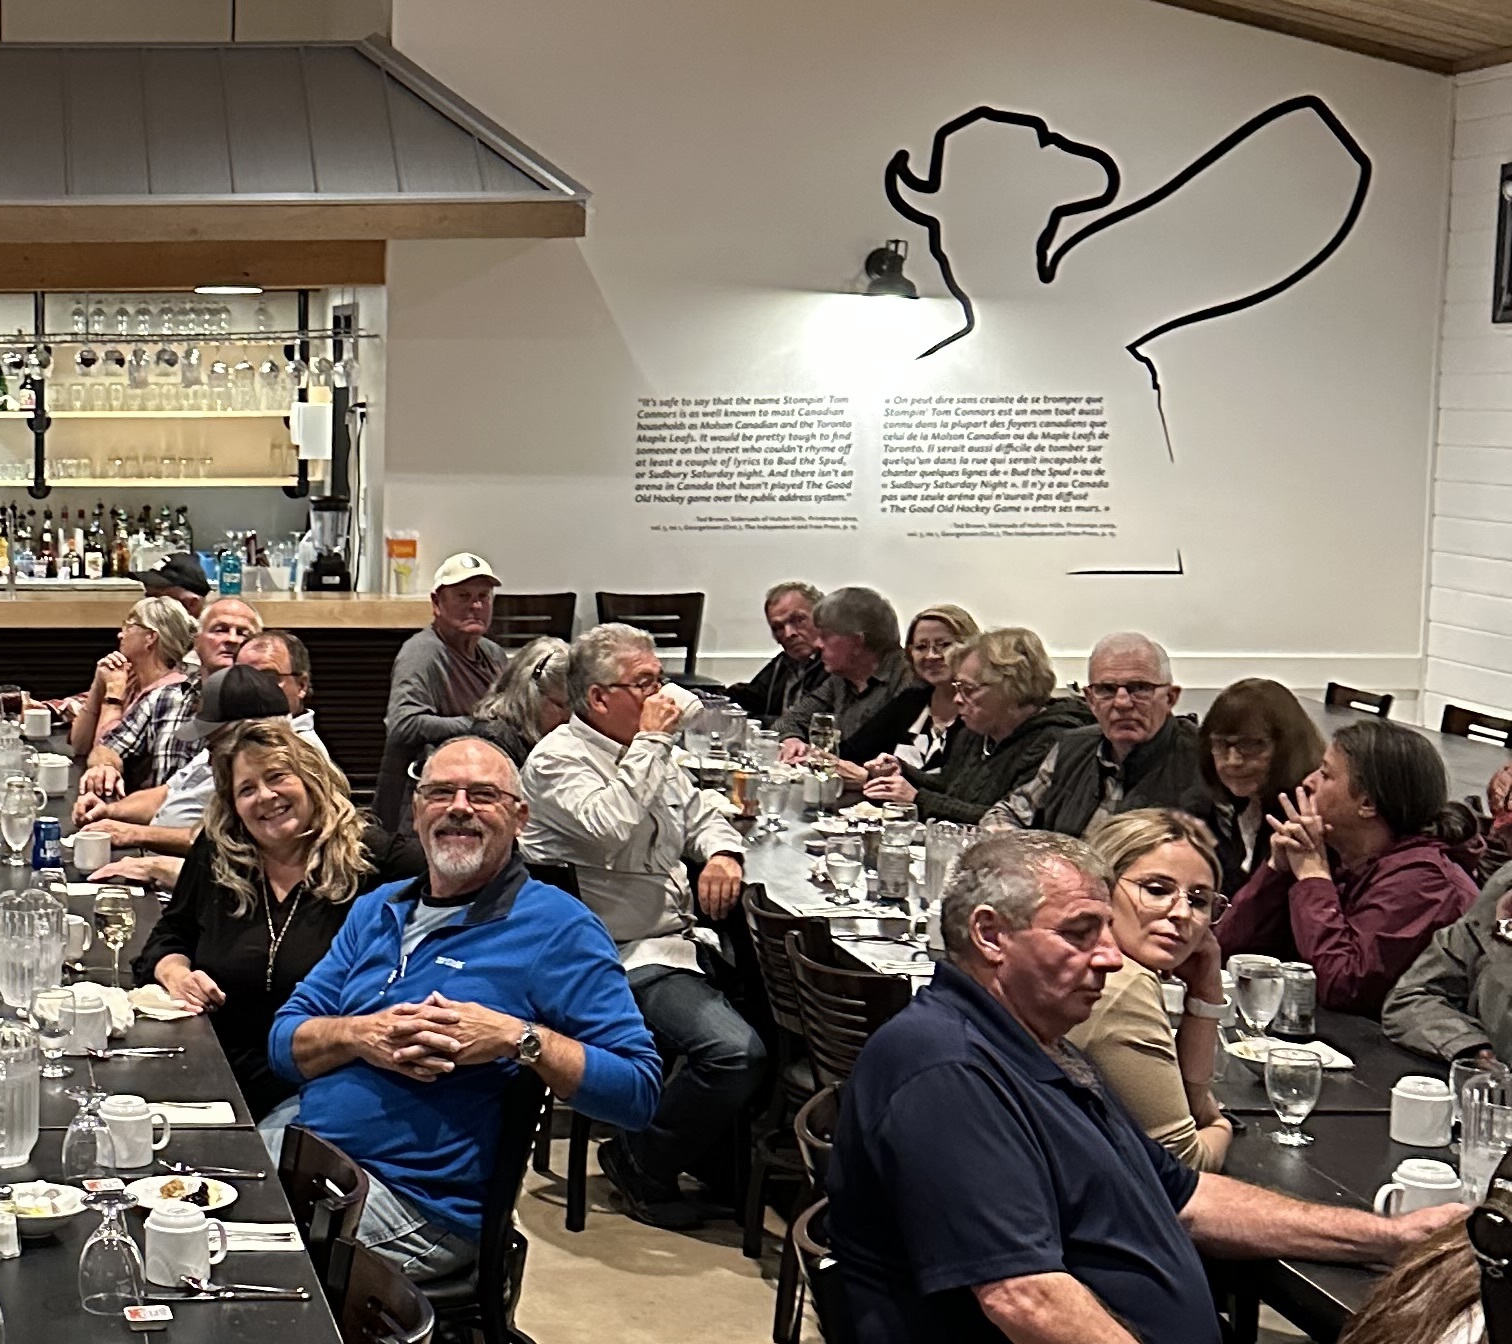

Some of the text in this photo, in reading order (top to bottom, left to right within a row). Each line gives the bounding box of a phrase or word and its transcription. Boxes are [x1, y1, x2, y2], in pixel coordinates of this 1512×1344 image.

[658, 396, 679, 408] safe
[681, 397, 692, 406] to
[694, 398, 710, 408] say
[712, 396, 733, 405] that
[735, 395, 751, 405] the
[829, 394, 848, 404] Tom
[894, 394, 908, 404] On
[911, 395, 932, 406] peut
[935, 394, 954, 404] dire
[979, 394, 1014, 404] crainte
[1016, 394, 1028, 404] de
[1042, 395, 1083, 406] tromper
[1085, 397, 1103, 406] que
[637, 406, 844, 418] Connors well known to most Canadian
[931, 406, 951, 416] Tom
[954, 406, 995, 416] Connors
[997, 407, 1012, 416] est
[1054, 407, 1076, 416] tout
[1078, 406, 1104, 416] aussi
[734, 420, 778, 429] Canadian
[780, 419, 797, 429] and
[799, 419, 813, 429] the
[816, 419, 852, 429] Toronto
[915, 419, 937, 428] dans
[989, 418, 1005, 428] des
[1007, 418, 1038, 430] foyers
[1088, 421, 1107, 430] que
[636, 433, 668, 444] Maple
[699, 432, 708, 442] It
[709, 432, 739, 442] would
[741, 432, 753, 441] be
[755, 433, 785, 443] pretty
[788, 431, 816, 443] tough
[819, 432, 829, 441] to
[832, 431, 851, 443] find
[907, 430, 917, 440] de
[967, 430, 1011, 440] Canadian
[1040, 430, 1070, 442] Maple
[1098, 430, 1110, 440] de
[694, 444, 710, 454] the
[712, 445, 739, 454] street
[741, 444, 762, 454] who
[764, 444, 803, 453] couldn't
[805, 443, 835, 455] rhyme
[838, 443, 851, 455] off
[883, 443, 923, 452] Toronto.
[937, 443, 965, 452] serait
[968, 442, 992, 452] aussi
[1033, 442, 1046, 452] de
[1048, 442, 1085, 452] tomber
[635, 456, 846, 468] at least couple of lyrics to Bud the Spud,
[882, 454, 931, 466] quelqu'un
[934, 454, 957, 464] dans
[990, 454, 1006, 466] qui
[1008, 454, 1037, 464] serait
[1039, 454, 1088, 466] incapable
[1089, 454, 1102, 464] de
[635, 471, 647, 479] or
[690, 468, 735, 480] Saturday
[736, 468, 764, 480] night.
[767, 468, 788, 478] And
[790, 468, 815, 477] there
[818, 468, 838, 477] isn't
[989, 467, 1001, 476] de
[1010, 467, 1029, 476] Bud
[1030, 467, 1046, 476] the
[1093, 467, 1105, 476] de
[676, 480, 714, 490] Canada
[715, 480, 737, 490] that
[739, 480, 768, 490] hasn't
[771, 480, 803, 492] played
[805, 480, 823, 489] The
[825, 480, 852, 489] Good
[933, 479, 978, 490] Saturday
[980, 479, 1008, 490] Night
[1030, 479, 1046, 490] n'y
[1071, 479, 1109, 488] Canada
[635, 493, 652, 502] Old
[653, 493, 686, 504] Hockey
[687, 495, 712, 504] game
[734, 492, 749, 502] the
[778, 492, 812, 501] address
[881, 493, 898, 503] pas
[900, 493, 918, 501] une
[920, 491, 944, 501] seule
[977, 491, 993, 503] qui
[995, 491, 1034, 501] n'aurait
[1036, 493, 1053, 503] pas
[889, 503, 906, 513] The
[908, 503, 934, 513] Good
[936, 503, 954, 513] Old
[956, 503, 991, 515] Hockey
[992, 503, 1021, 513] Game
[1031, 504, 1056, 513] entre
